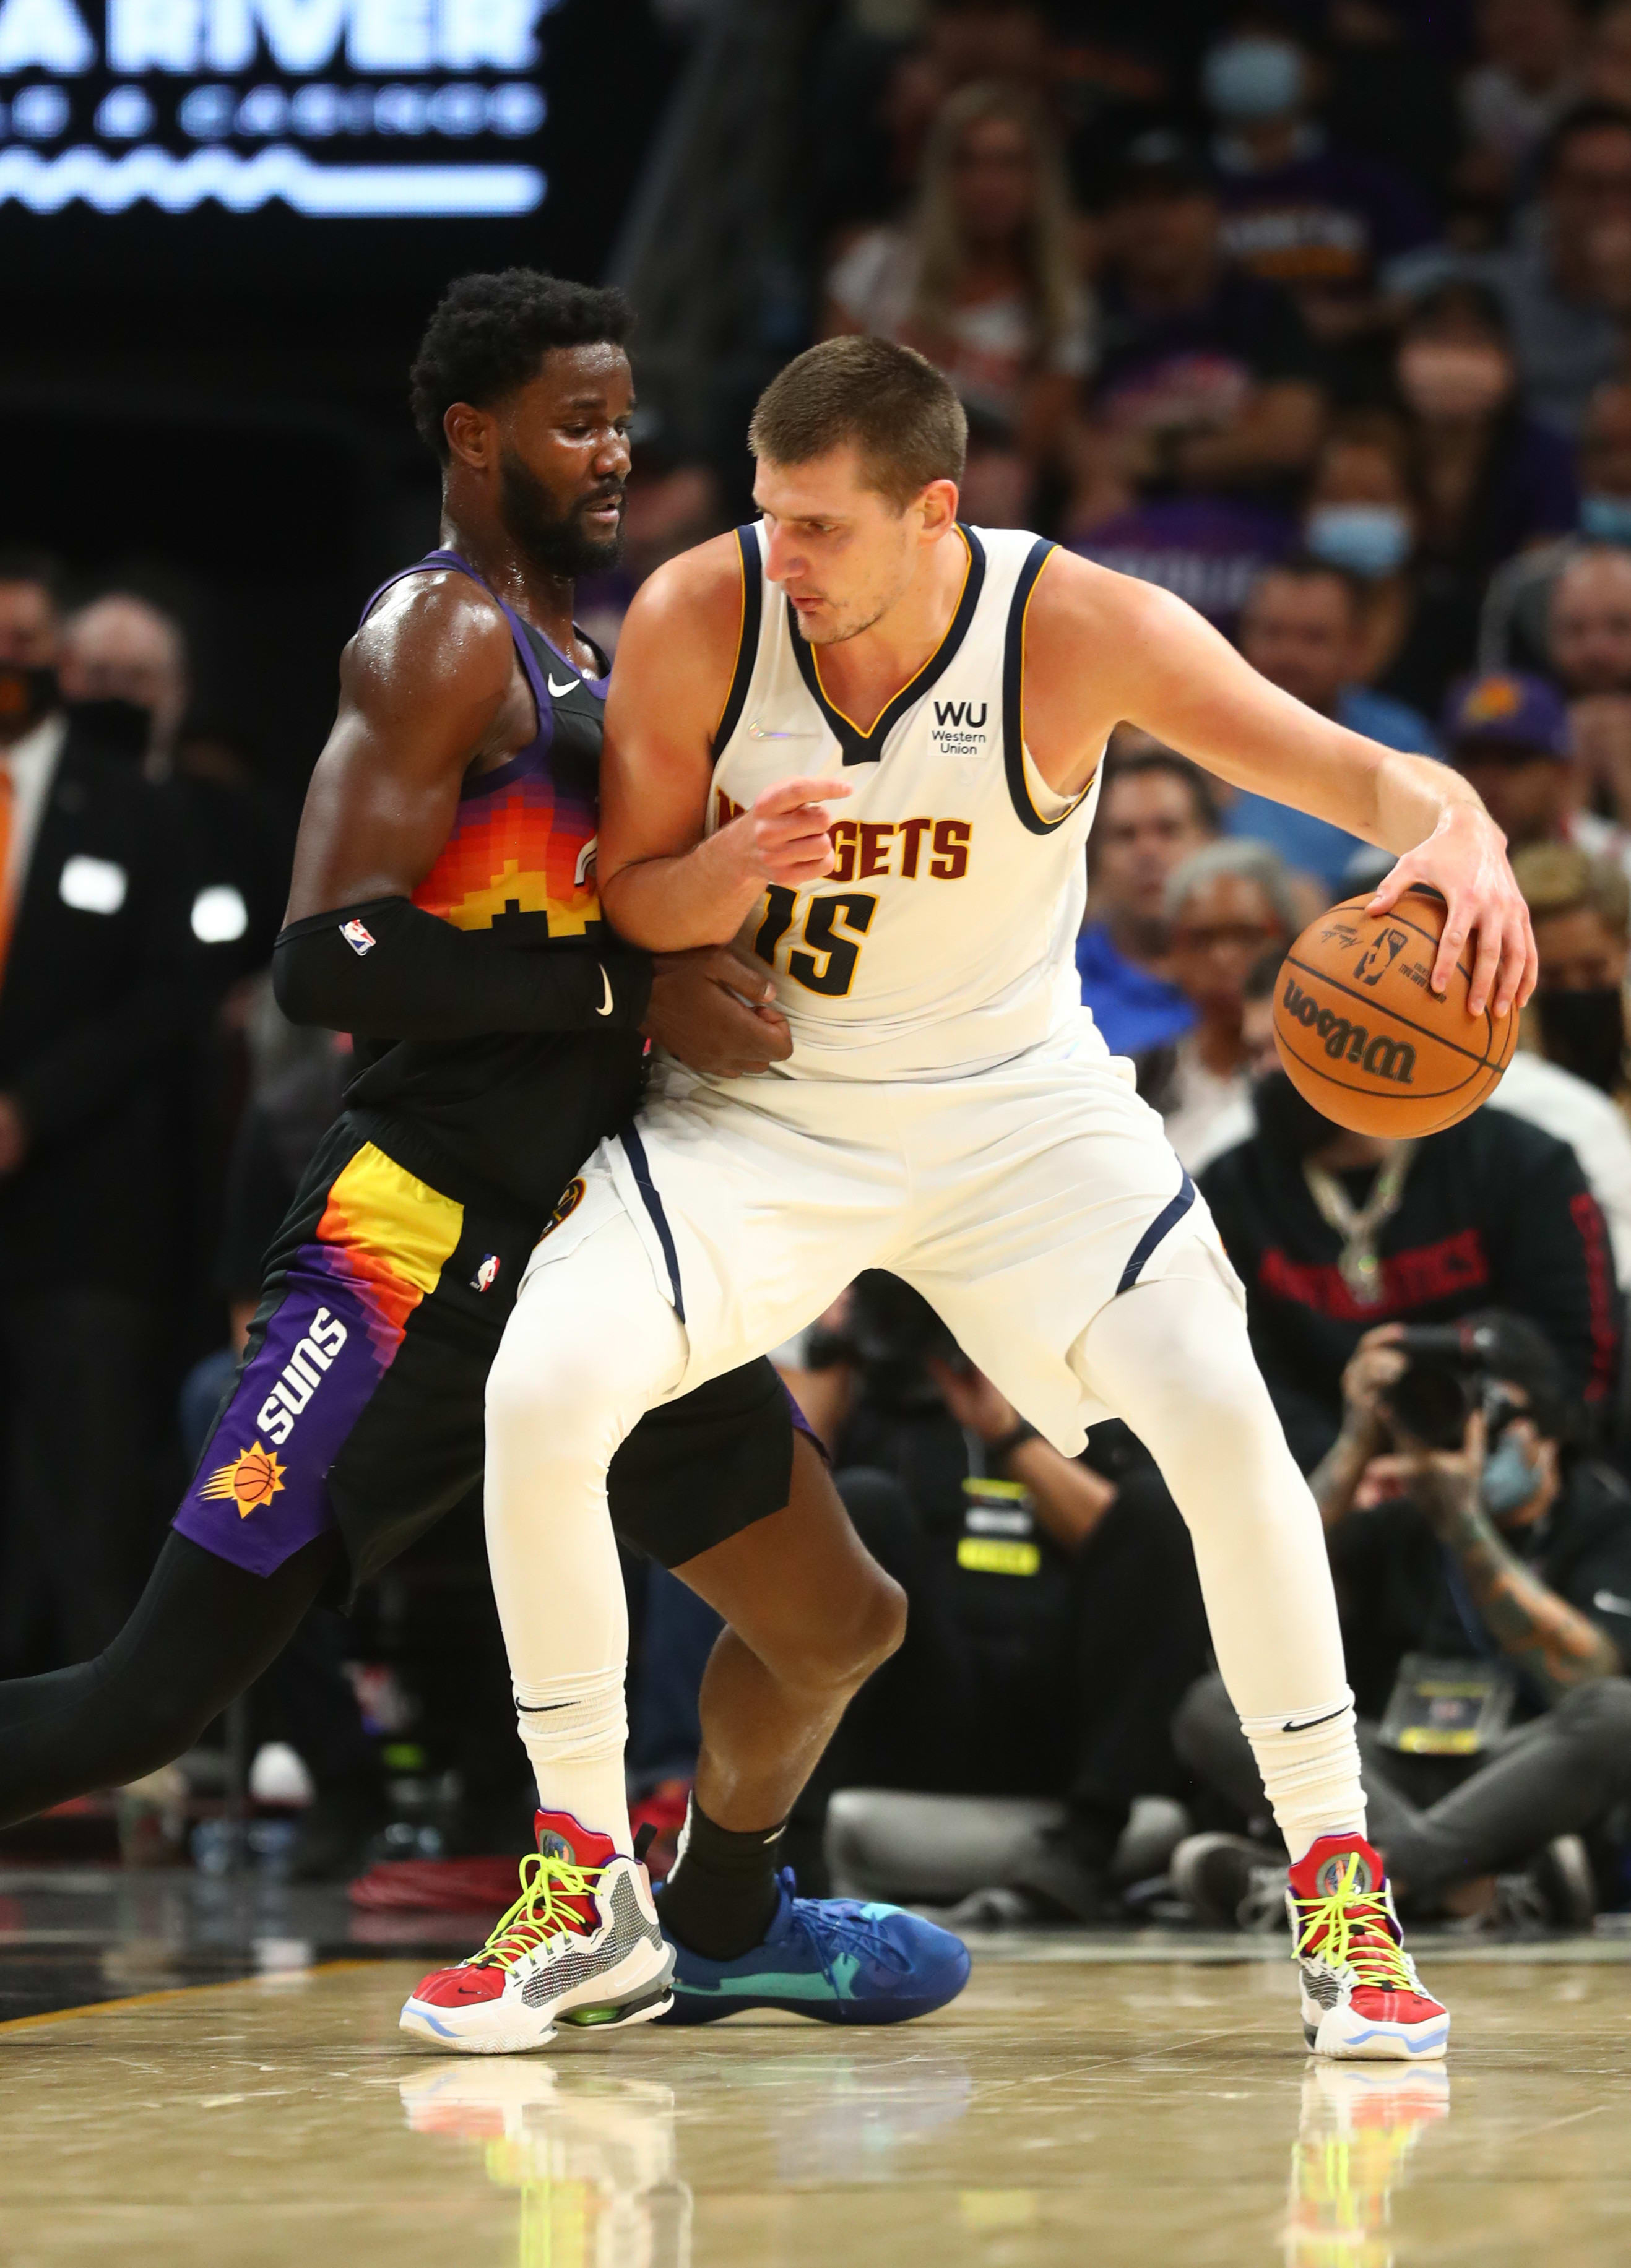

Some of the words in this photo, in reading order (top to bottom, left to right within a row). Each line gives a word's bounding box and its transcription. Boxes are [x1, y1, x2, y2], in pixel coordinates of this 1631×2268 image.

[932, 730, 986, 743] Western
[933, 701, 987, 728] WU
[940, 743, 977, 755] Union
[716, 786, 972, 882] GETS
[753, 883, 880, 999] 15
[1283, 977, 1417, 1085] Wilson
[256, 1306, 348, 1446] SUNS
